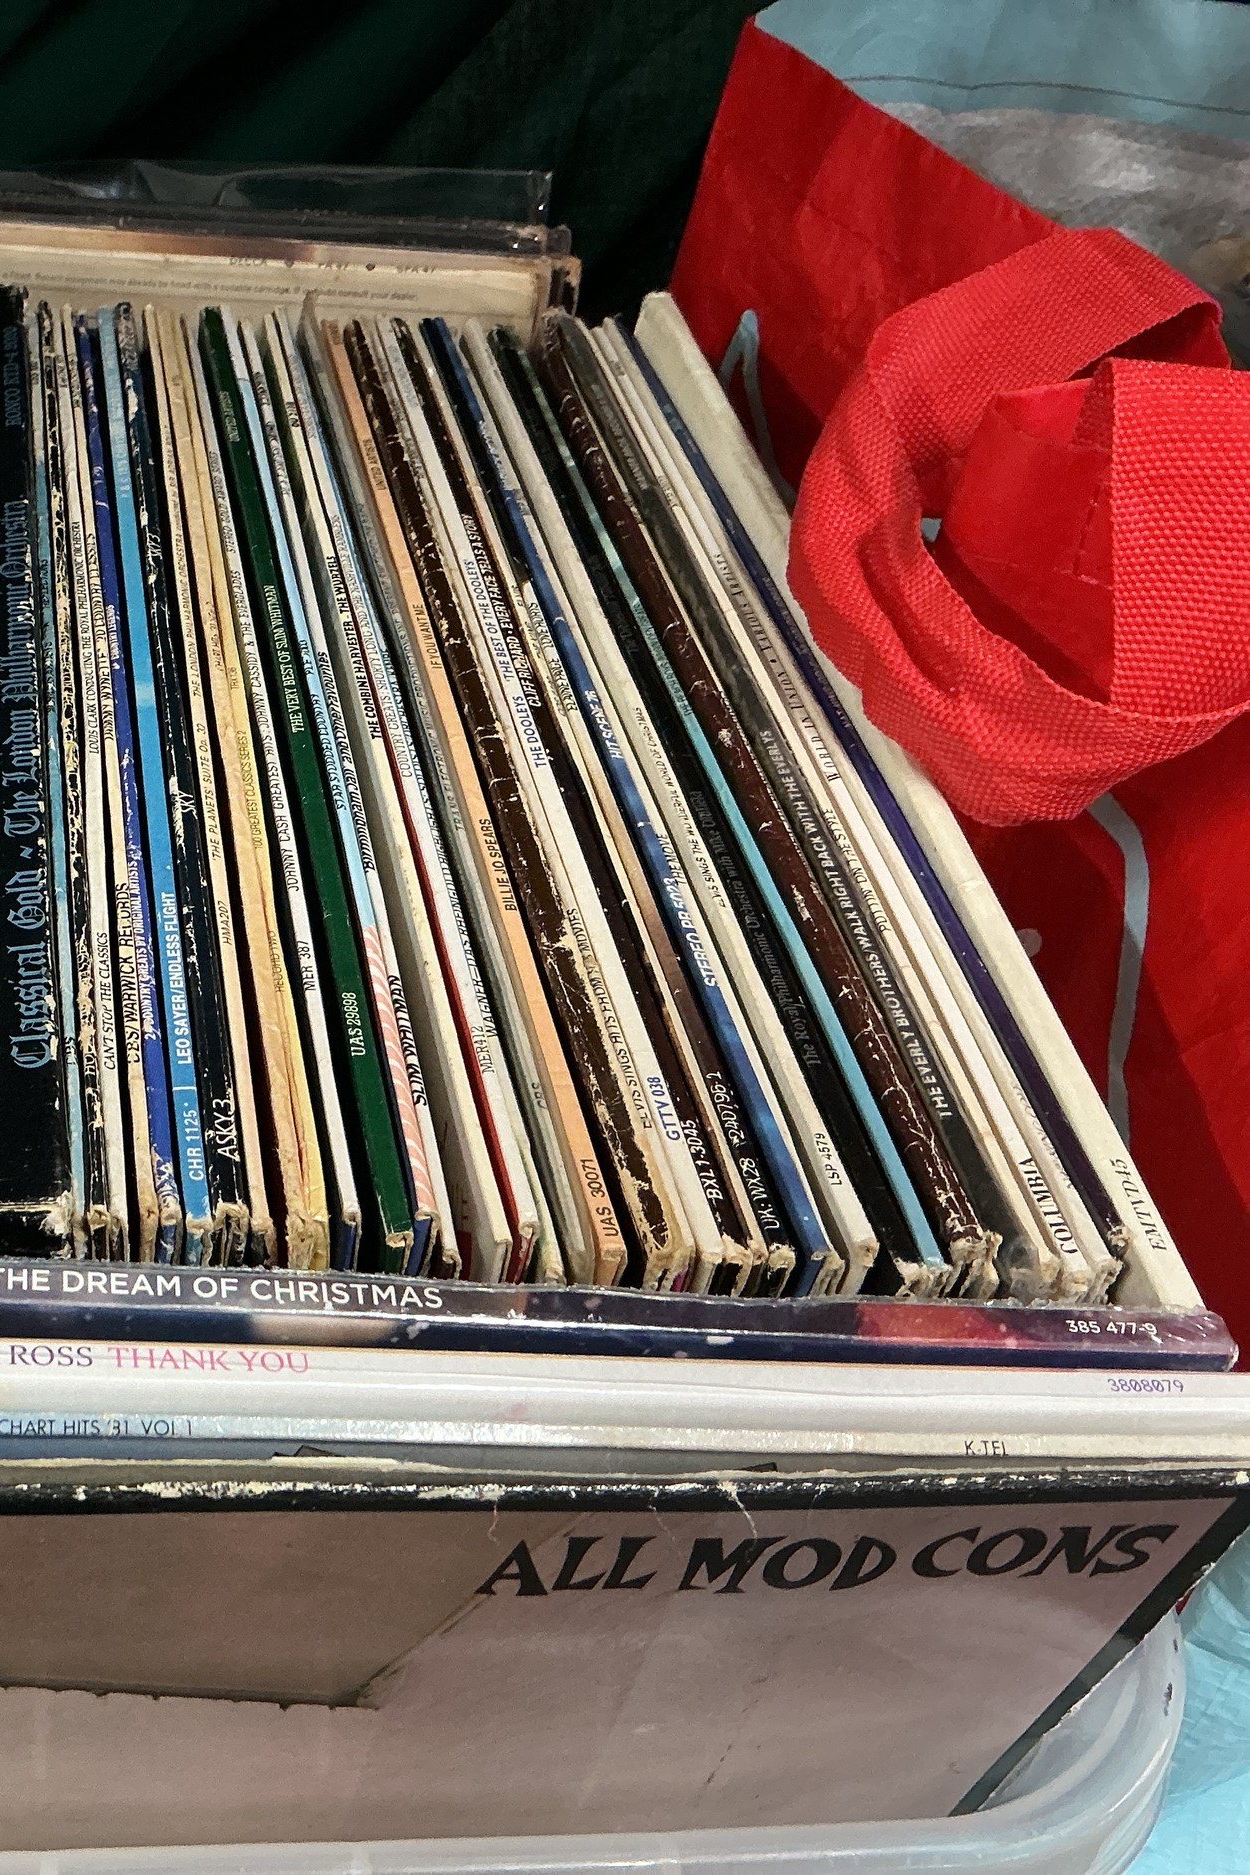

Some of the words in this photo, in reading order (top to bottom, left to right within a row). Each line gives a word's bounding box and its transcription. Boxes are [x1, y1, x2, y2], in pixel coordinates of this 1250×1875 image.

[342, 620, 365, 673] HARVESTER
[505, 636, 533, 678] RICHARD
[279, 663, 296, 686] BEST
[283, 686, 301, 711] VERY
[355, 674, 376, 718] COMBINE
[511, 695, 539, 742] DOOLEYS
[0, 709, 38, 786] London
[389, 731, 413, 777] COUNTRY
[758, 730, 792, 774] EVERLYS
[779, 775, 803, 799] THE
[1, 789, 40, 837] The
[275, 815, 291, 842] CASH
[790, 801, 820, 832] WITH
[478, 818, 501, 858] SPEARS
[807, 835, 836, 867] BACK
[4, 868, 47, 929] Gold
[495, 877, 517, 910] BILLIE
[823, 869, 856, 907] RIGHT
[160, 891, 180, 940] FLIGHT
[216, 900, 233, 945] HMA207
[565, 908, 591, 950] MOVIES
[96, 931, 110, 979] CLASSICS
[749, 932, 796, 1004] Philharmonic
[842, 911, 913, 1026] BROTHERS/WALK
[6, 939, 53, 1068] Classical
[138, 982, 154, 1023] COUNTRY
[164, 933, 189, 1035] SAYER/ENDLESS
[339, 991, 362, 1025] 29898
[386, 974, 417, 1057] WHITMAN
[781, 1006, 812, 1039] Royal
[174, 1037, 192, 1064] LEO
[469, 1025, 495, 1073] MER412
[898, 1030, 938, 1083] EVERLY
[404, 1063, 429, 1105] SLIM
[924, 1086, 955, 1117] THE
[214, 1115, 238, 1157] ASKY
[653, 1099, 682, 1140] GTTV
[186, 1147, 204, 1180] CHR
[811, 1132, 834, 1159] 4579
[580, 1158, 606, 1197] 30071
[736, 1157, 768, 1199] WX28
[595, 1206, 619, 1236] UAS
[754, 1202, 781, 1229] UK:
[1013, 1156, 1082, 1254] COLUMBIA
[1102, 1157, 1174, 1250] EMTVD45
[61, 1270, 183, 1297] DREAM
[193, 1275, 241, 1299] OF
[250, 1278, 444, 1309] CHRISTMAS
[1066, 1319, 1101, 1334] 385
[1105, 1321, 1158, 1336] 477-9
[9, 1344, 94, 1368] ROSS
[107, 1345, 233, 1372] THANK
[237, 1349, 311, 1375] YOU
[1106, 1378, 1184, 1393] 3808079
[62, 1419, 101, 1436] HITS
[963, 1440, 1009, 1457] K-TEL
[474, 1536, 658, 1597] ALL
[679, 1533, 898, 1595] MOD
[910, 1523, 1180, 1579] CONS
